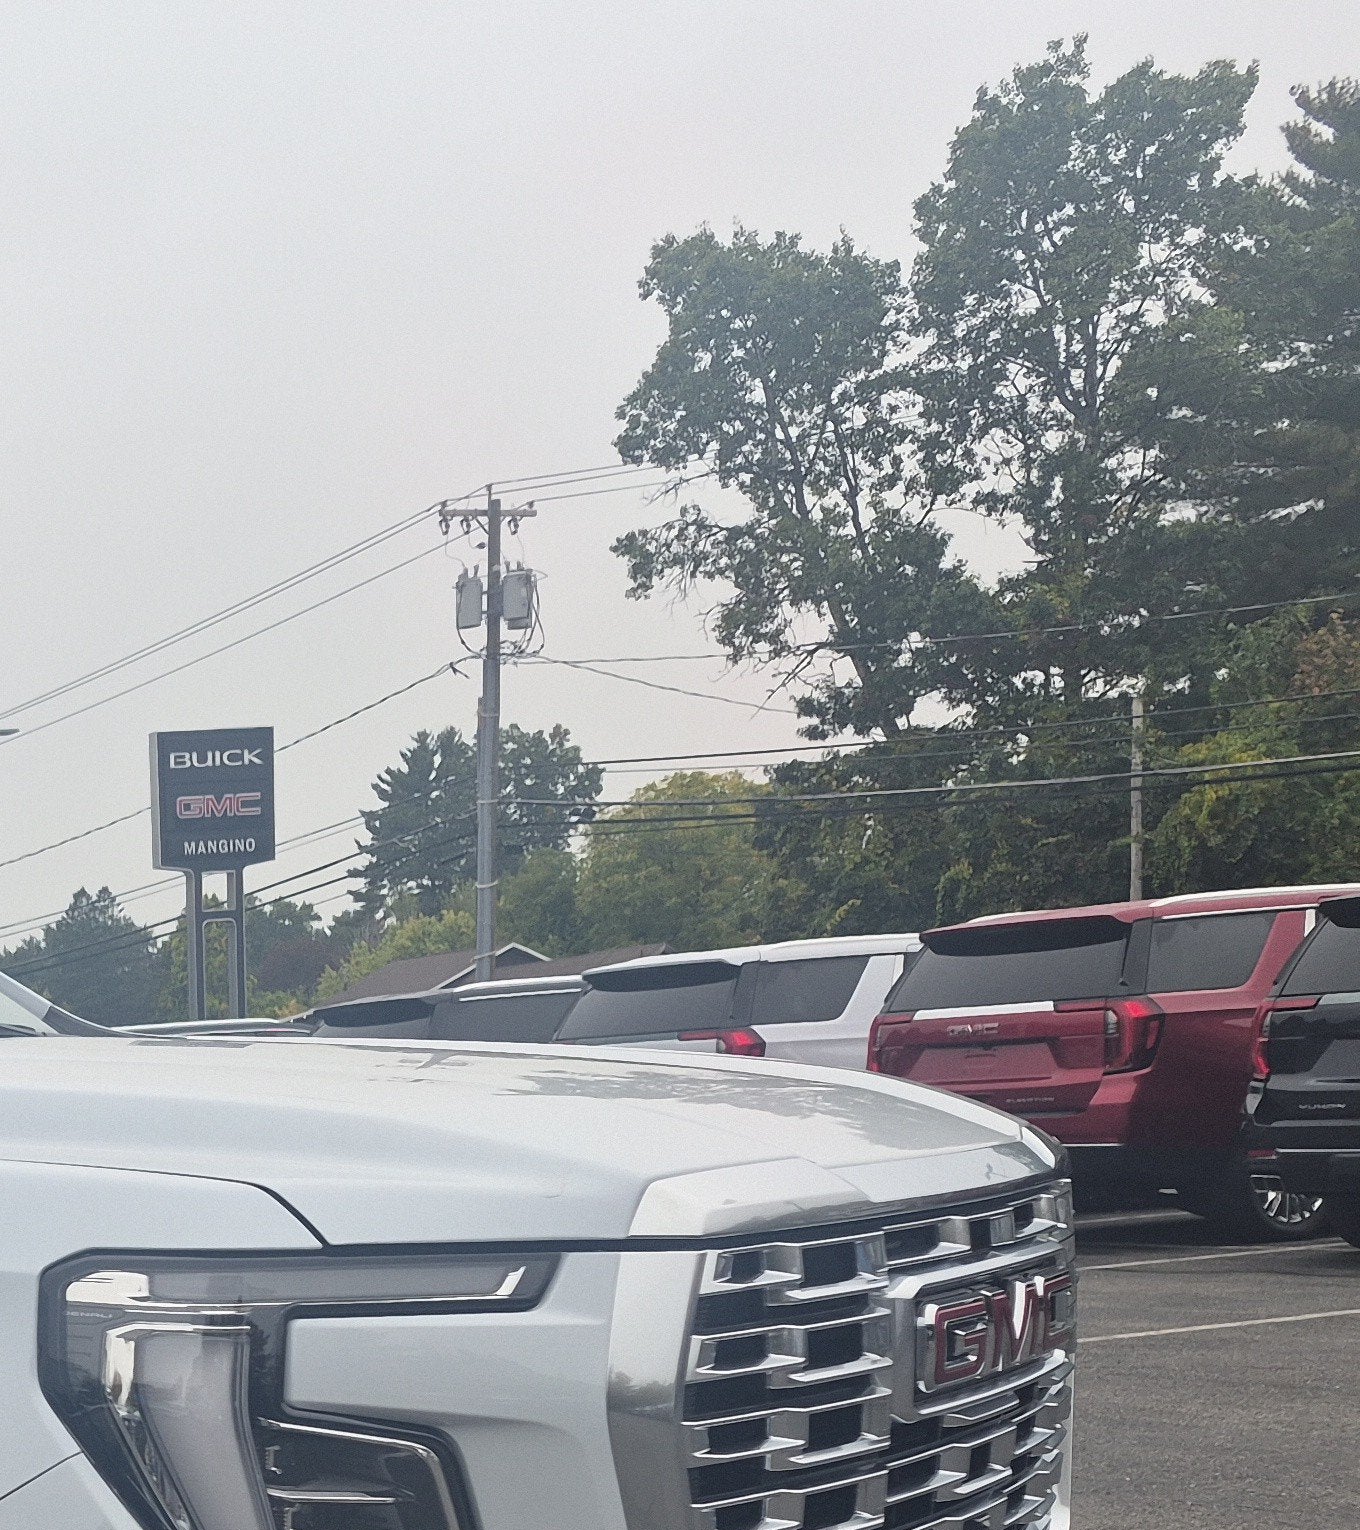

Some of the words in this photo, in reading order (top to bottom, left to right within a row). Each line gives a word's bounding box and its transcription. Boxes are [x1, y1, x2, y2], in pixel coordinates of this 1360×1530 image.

[170, 749, 263, 768] BUICK
[177, 792, 260, 818] GMC
[184, 838, 255, 855] MANGINO
[917, 1275, 1074, 1392] GMC
